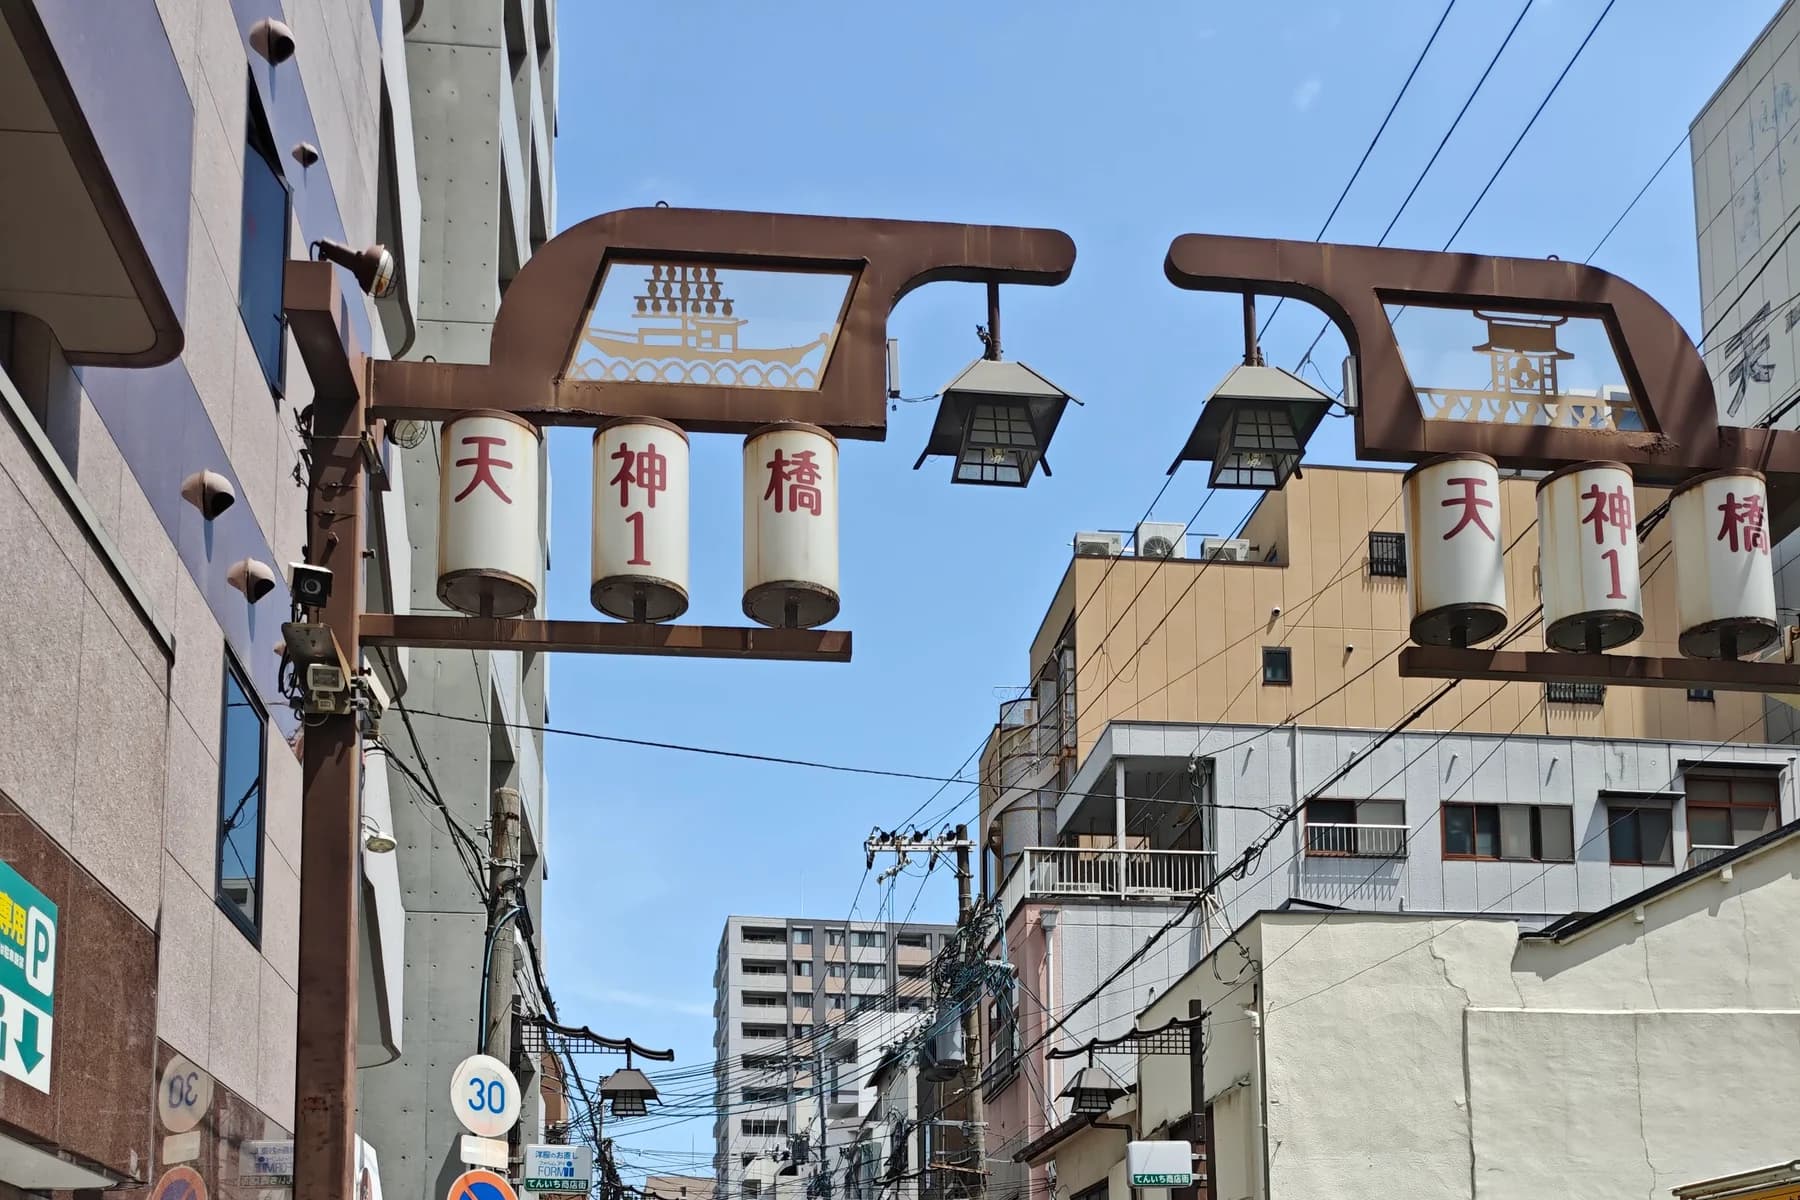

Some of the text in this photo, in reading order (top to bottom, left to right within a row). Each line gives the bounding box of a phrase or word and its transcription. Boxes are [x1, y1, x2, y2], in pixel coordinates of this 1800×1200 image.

[454, 436, 514, 504] 天
[1441, 477, 1496, 542] 天
[468, 1077, 506, 1115] 30
[528, 1179, 587, 1190] てんいち商店街
[1135, 1174, 1190, 1184] てんいち商店街
